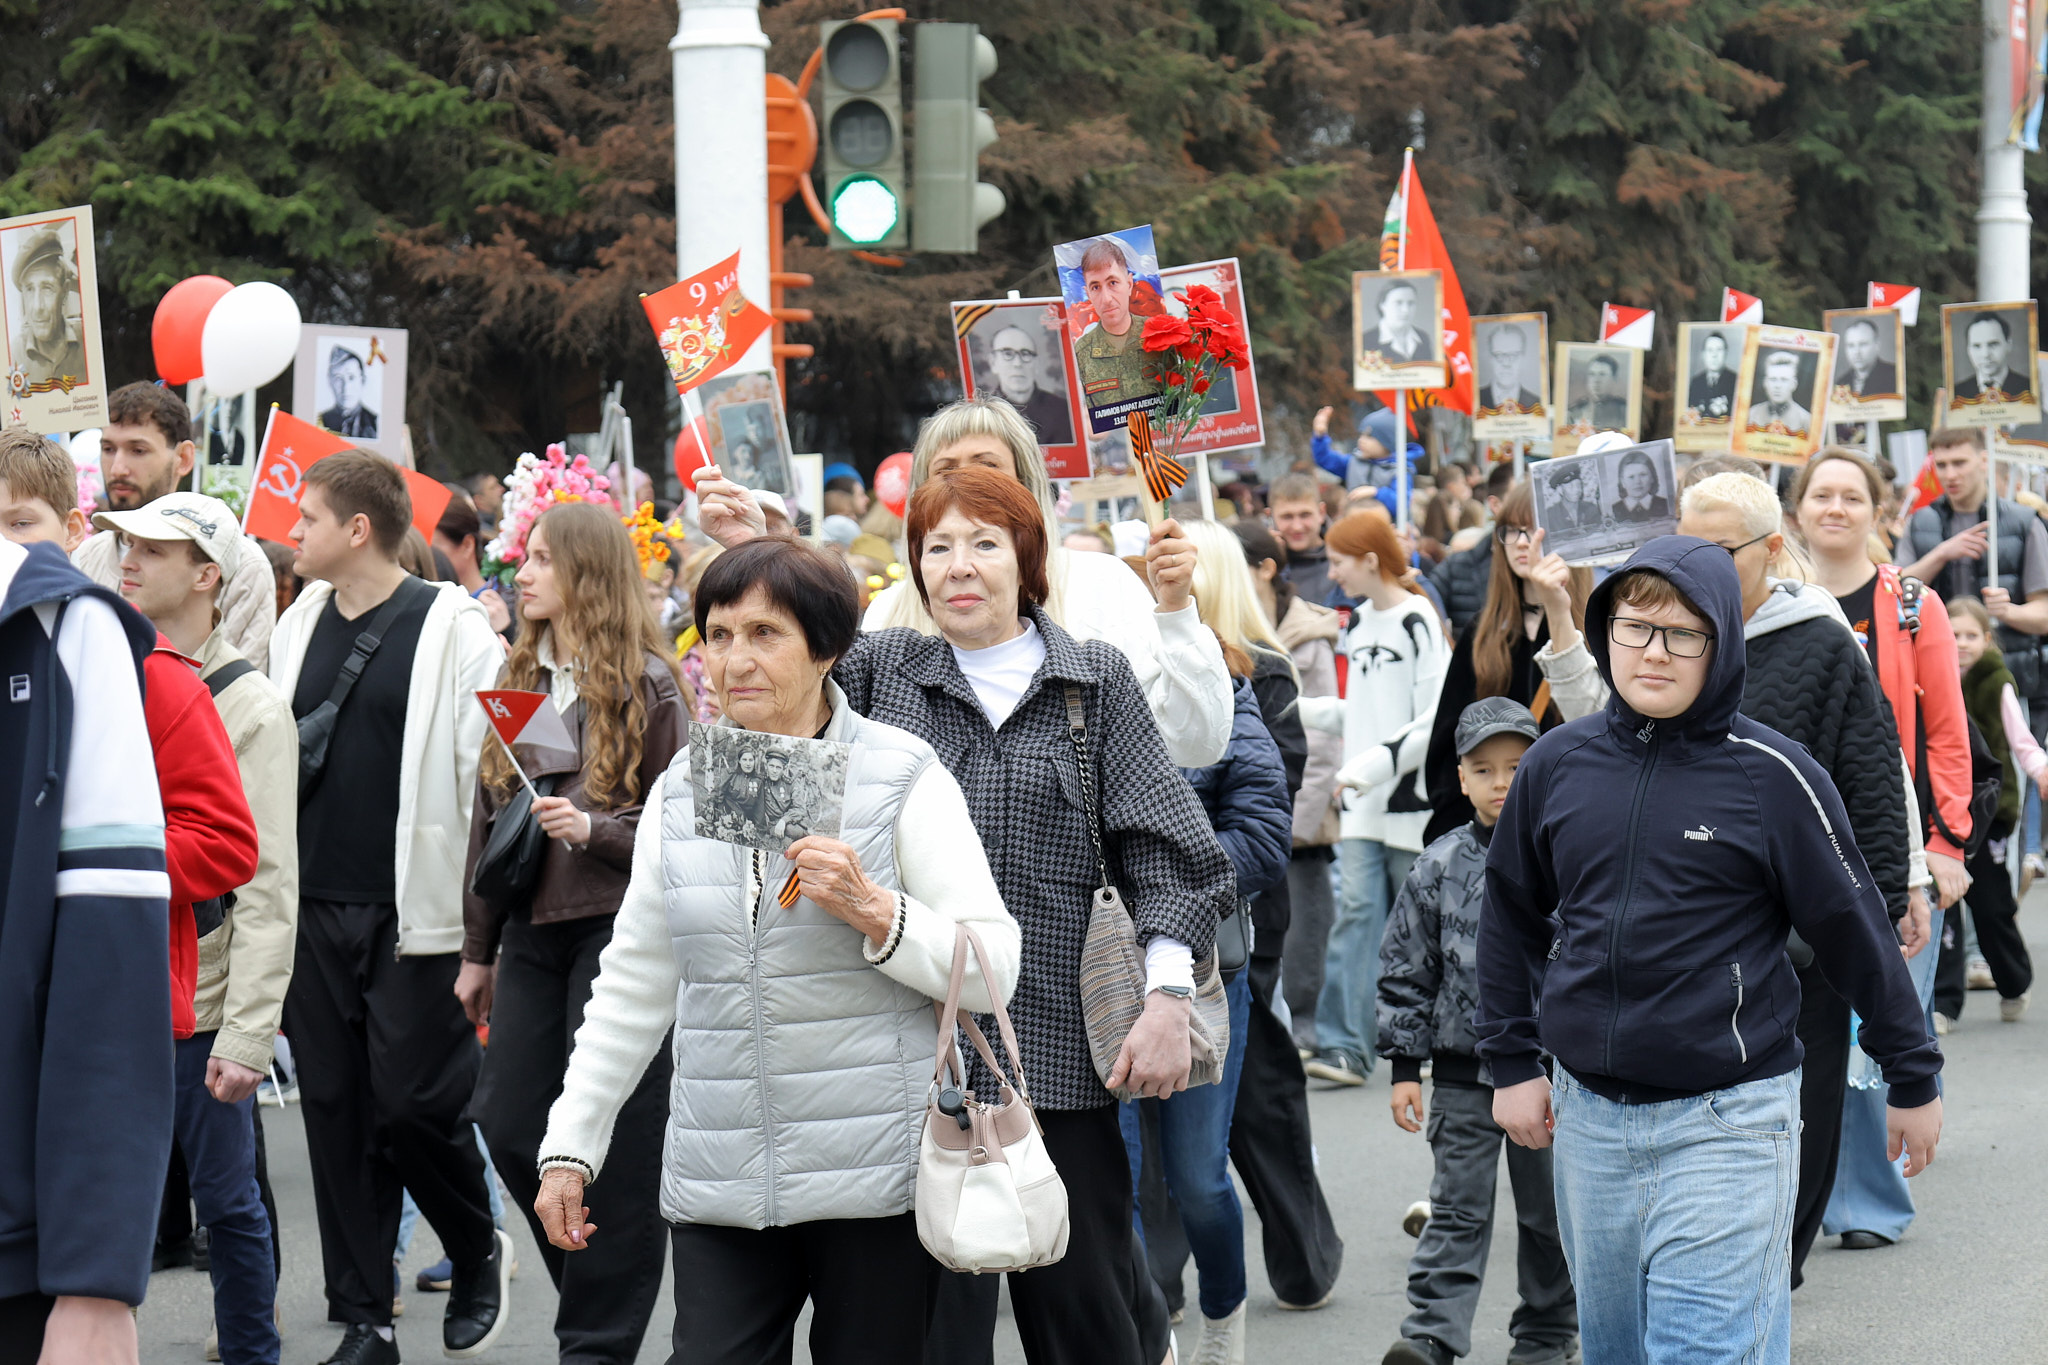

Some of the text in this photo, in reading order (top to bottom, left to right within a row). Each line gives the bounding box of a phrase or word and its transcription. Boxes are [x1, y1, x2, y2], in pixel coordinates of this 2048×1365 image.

[689, 270, 738, 308] 9 МА
[1094, 406, 1120, 419] ГАЛИМОВ
[1120, 402, 1138, 413] МАРАТ
[1113, 415, 1128, 426] 13.01.
[1684, 829, 1709, 842] PUMA
[1828, 834, 1862, 889] PUMA SPORT
